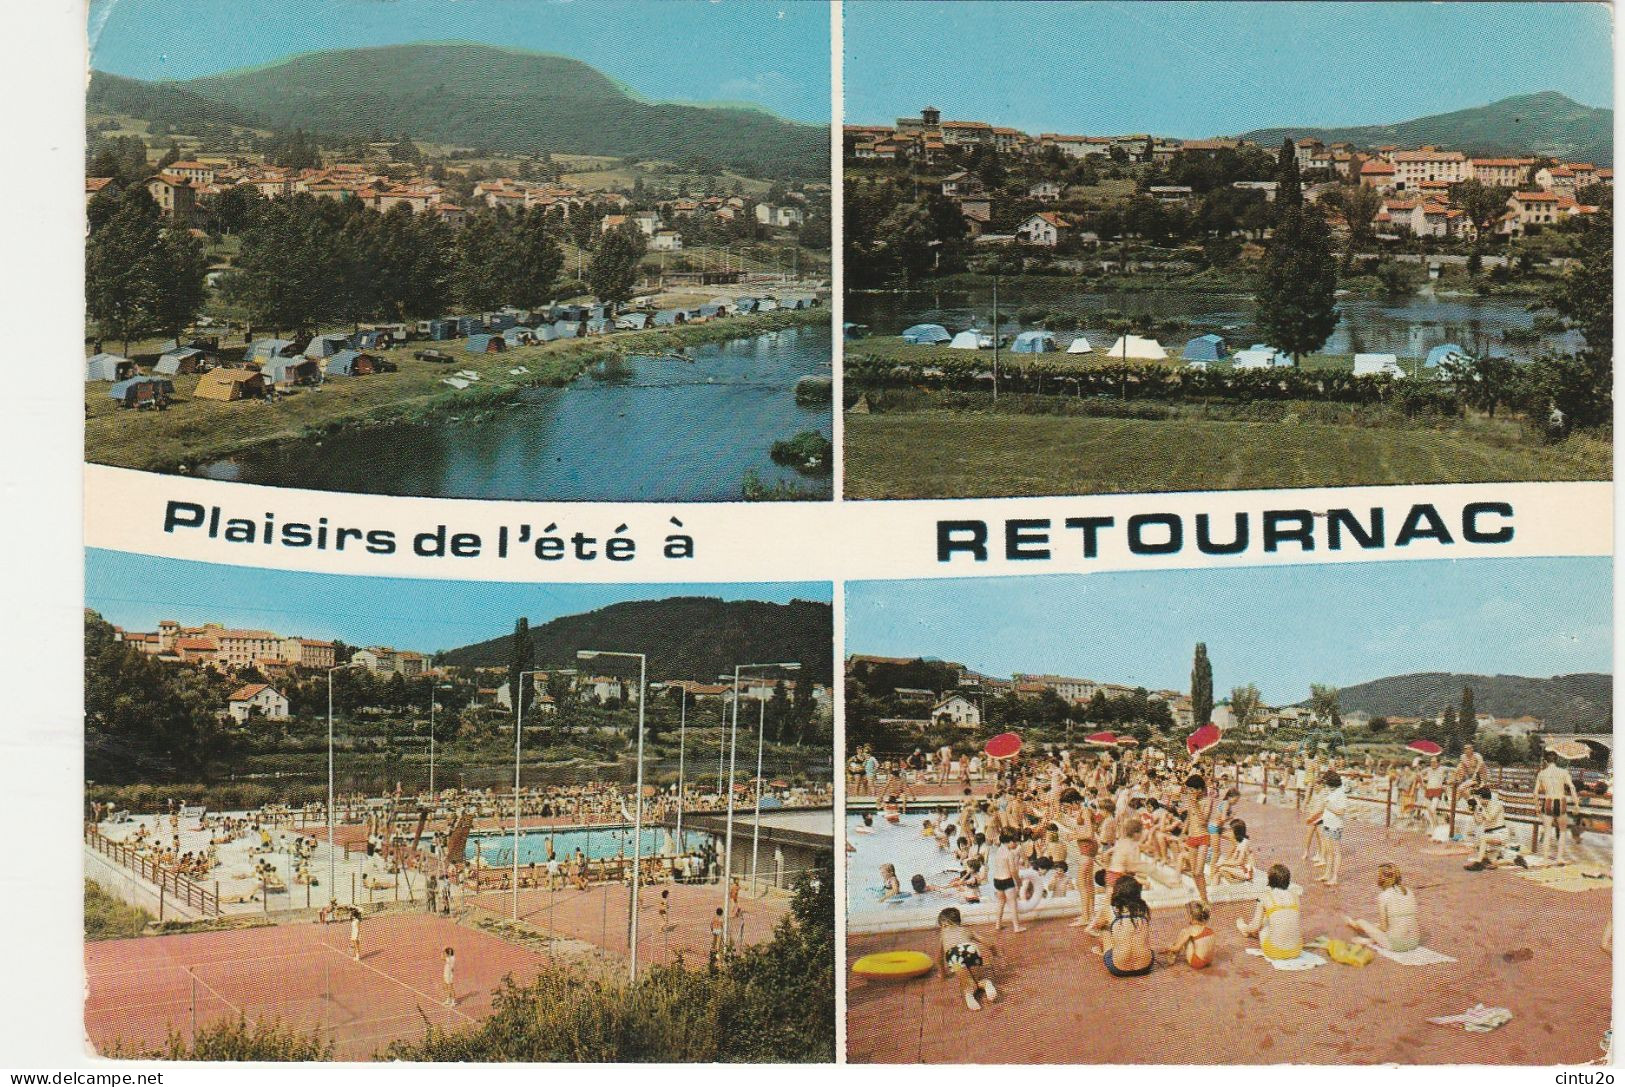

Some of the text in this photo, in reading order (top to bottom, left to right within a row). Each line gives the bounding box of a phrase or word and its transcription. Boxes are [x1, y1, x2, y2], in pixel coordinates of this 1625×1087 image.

[163, 500, 695, 562] Plaisirs de l'été à
[936, 501, 1514, 562] RETOURNAC
